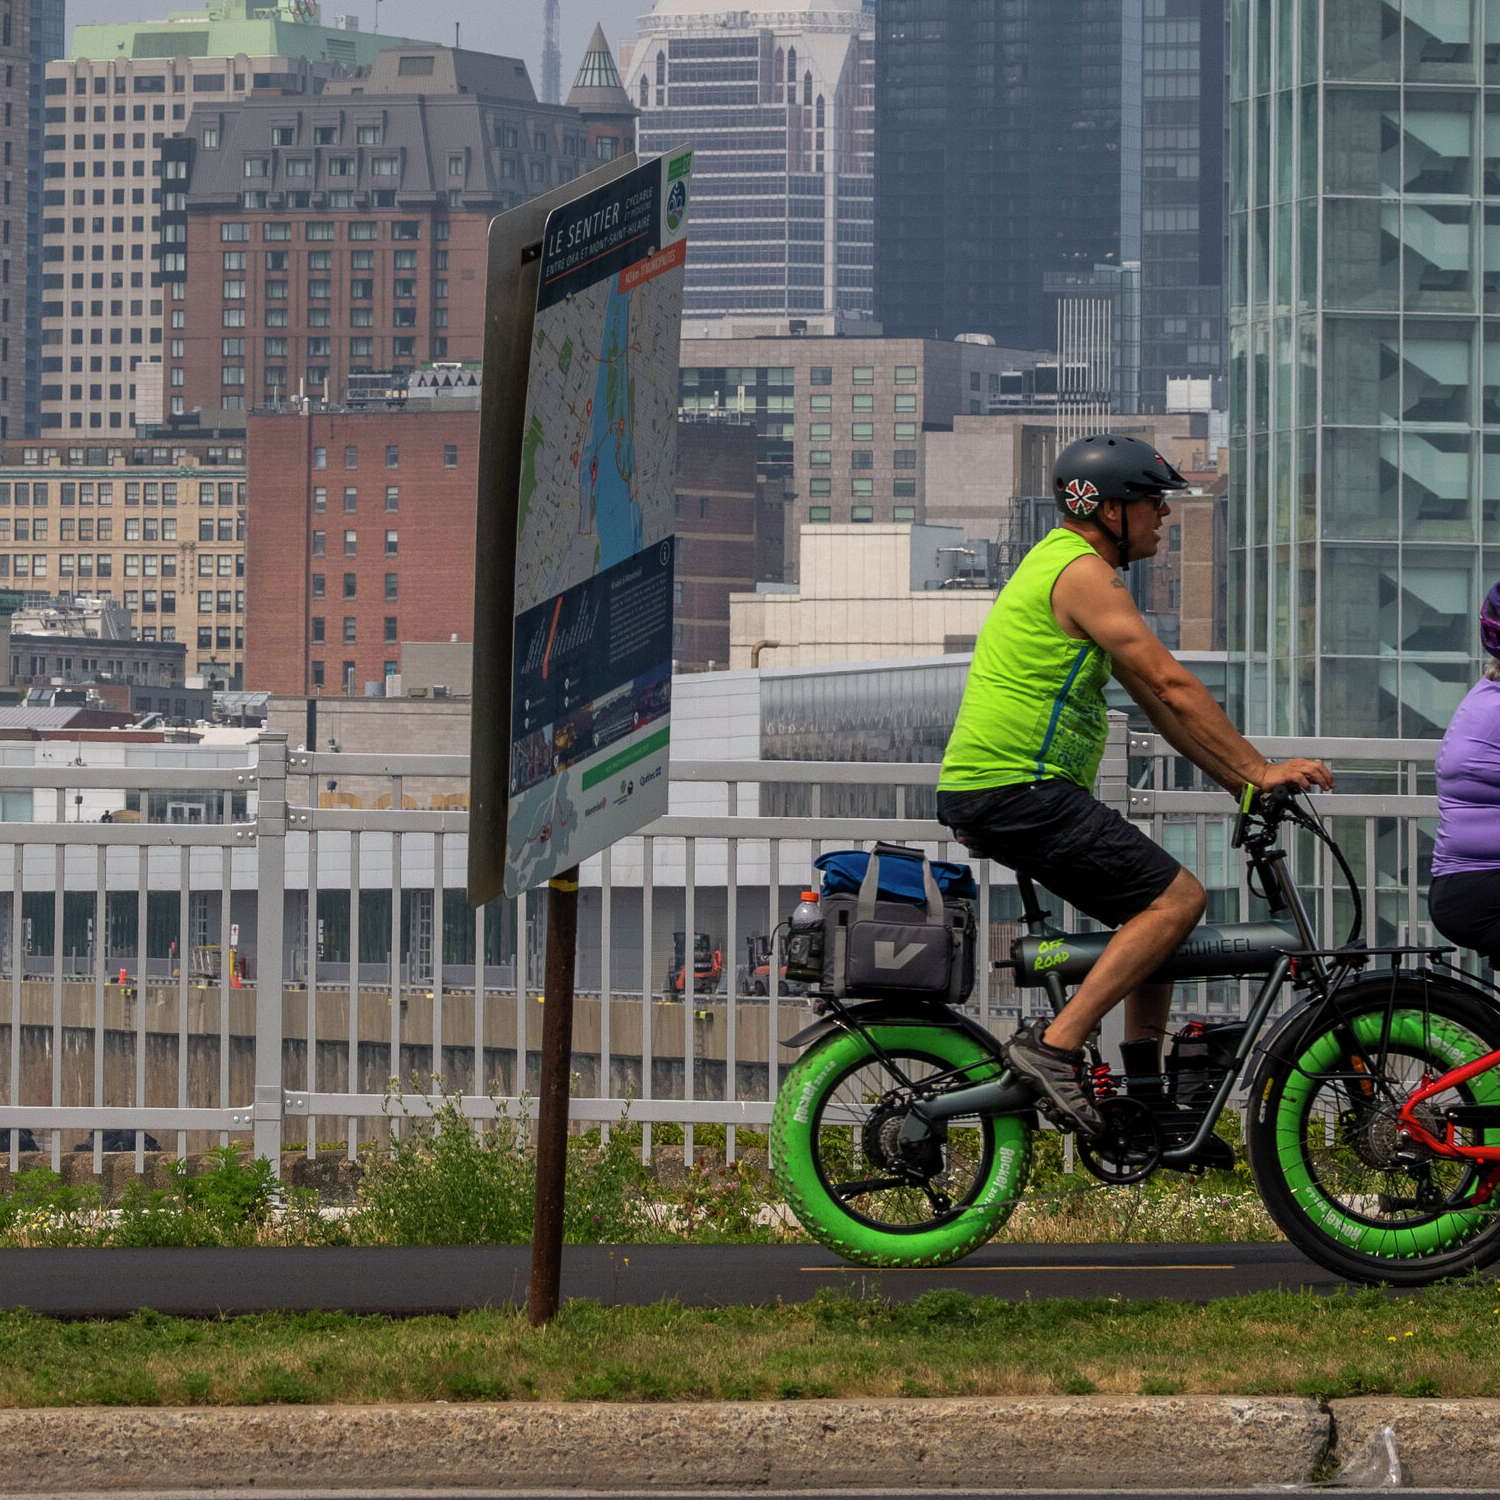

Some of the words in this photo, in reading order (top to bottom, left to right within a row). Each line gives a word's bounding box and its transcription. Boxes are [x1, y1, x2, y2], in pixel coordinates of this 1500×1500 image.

[626, 186, 654, 210] CYCLABLE
[549, 229, 564, 257] LE
[567, 202, 620, 248] SENTIER
[546, 258, 565, 278] ENTRE
[566, 251, 579, 270] OKA
[580, 246, 588, 261] ET
[588, 216, 650, 257] MONT-SAINT-HILAIRE
[1038, 937, 1065, 954] OFF
[1174, 938, 1257, 956] SWHEEL
[1034, 951, 1069, 971] ROAD
